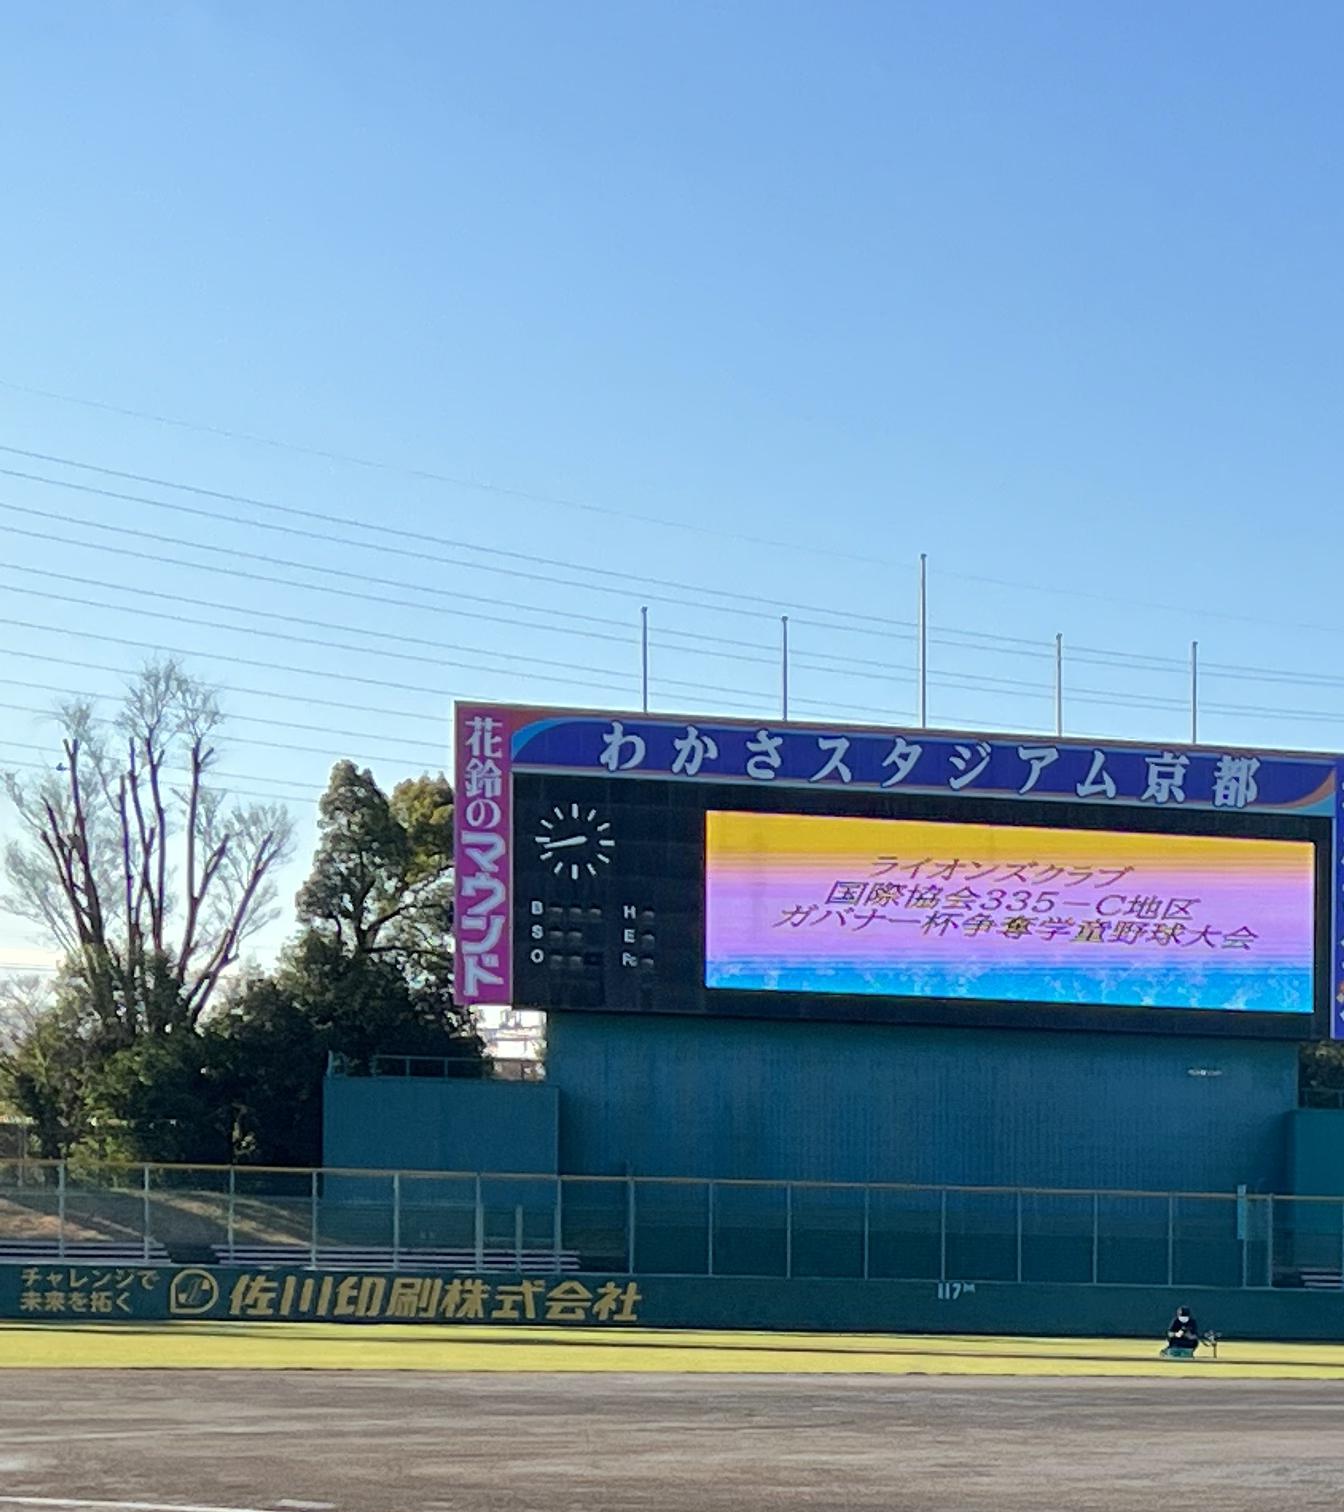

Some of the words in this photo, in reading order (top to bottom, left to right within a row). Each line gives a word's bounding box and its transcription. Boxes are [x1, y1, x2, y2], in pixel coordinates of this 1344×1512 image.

[600, 720, 1261, 809] わかさスタジアム京都
[461, 716, 506, 997] 花鈴のマウンド
[869, 856, 1135, 888] ライオンズクラブ
[623, 905, 637, 919] H
[531, 924, 544, 939] S
[623, 928, 636, 943] E
[772, 904, 1260, 950] ガバナー杯争奪学童野球大会
[21, 1267, 160, 1290] チャレンジで
[20, 1291, 134, 1314] 未来を拓く
[229, 1274, 643, 1321] 佐川印刷株式会社
